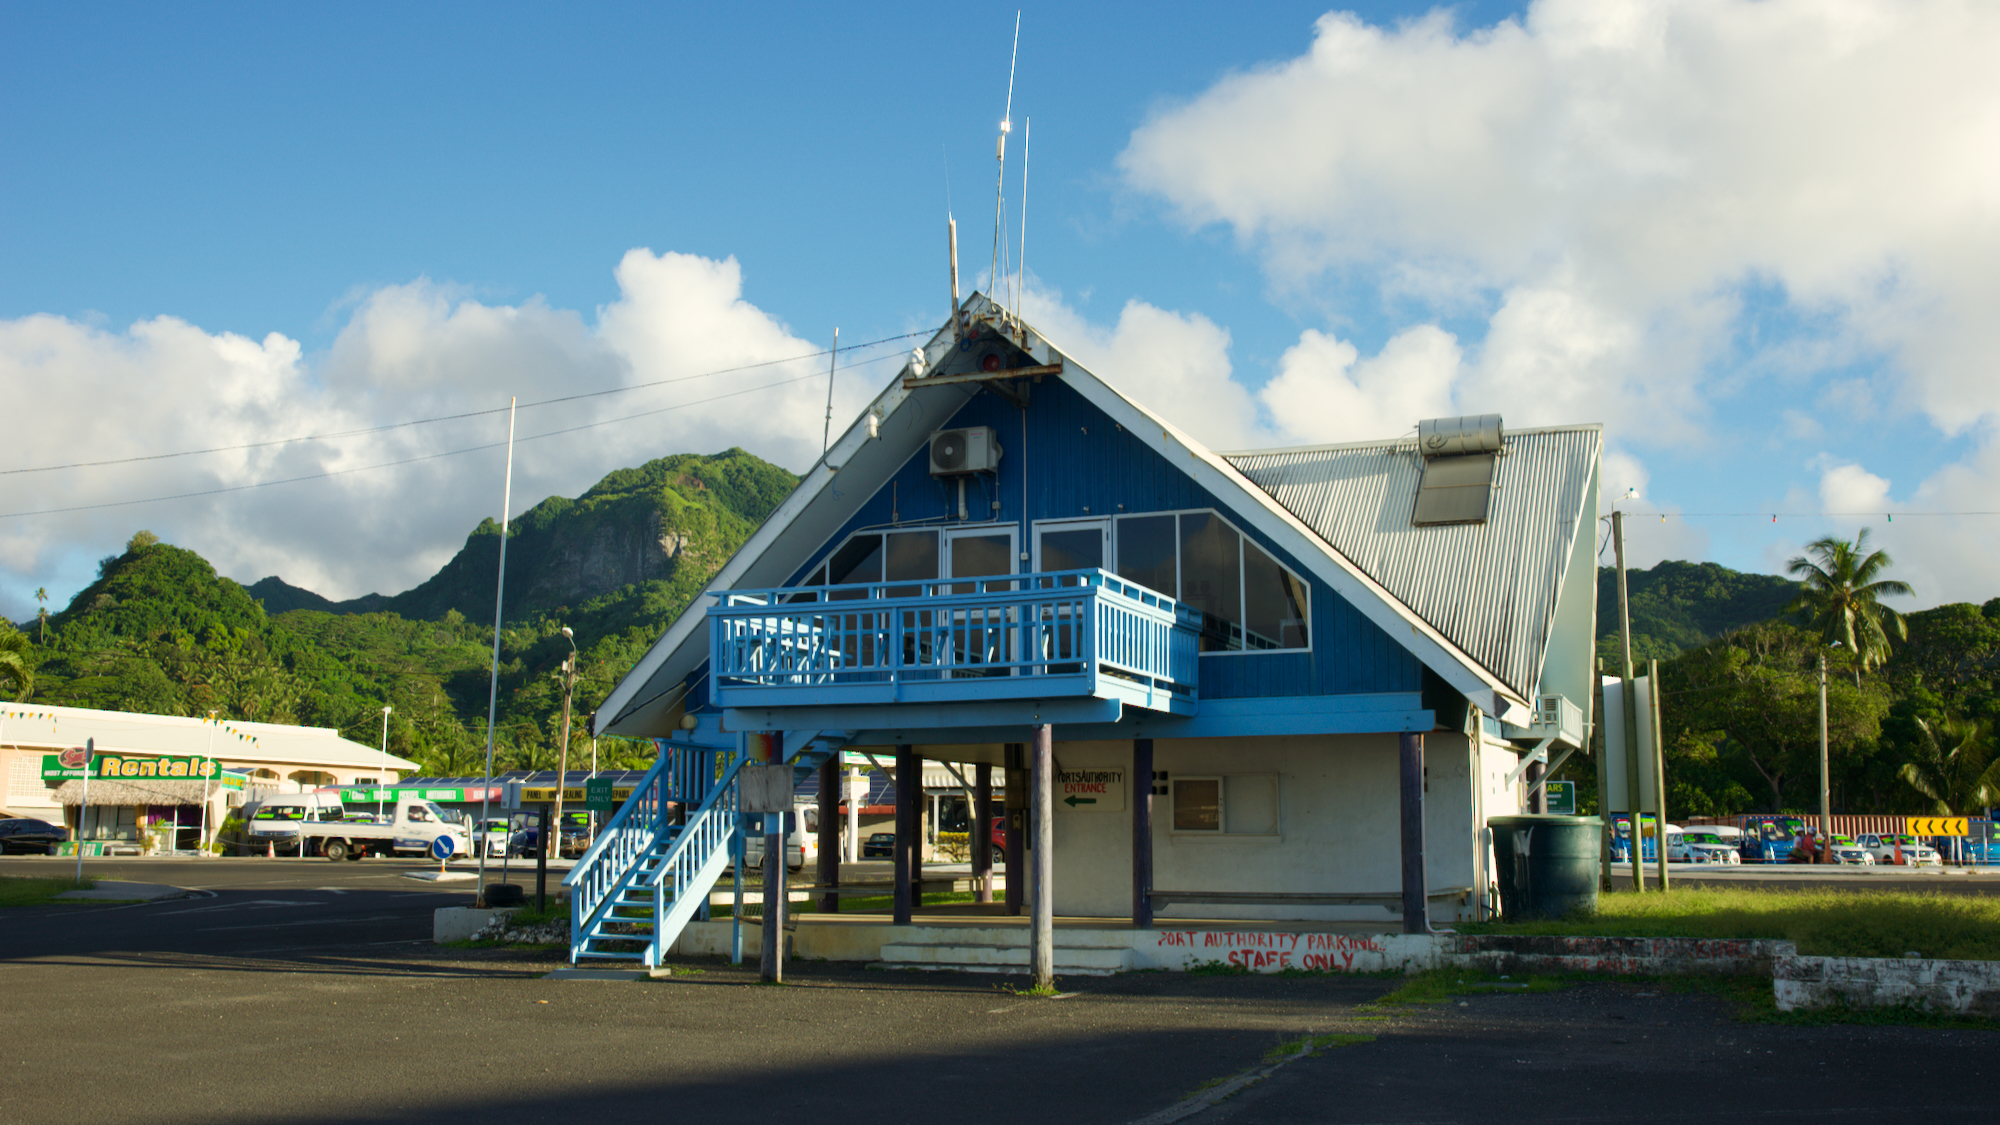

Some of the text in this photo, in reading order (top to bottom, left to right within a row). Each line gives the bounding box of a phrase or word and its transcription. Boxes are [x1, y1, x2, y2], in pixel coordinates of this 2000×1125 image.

[100, 757, 216, 777] Rentals
[1064, 783, 1107, 793] ENTRANCE
[1547, 784, 1563, 792] ARS
[373, 790, 392, 800] TRCKS
[527, 790, 542, 799] PANEL
[612, 789, 630, 799] EPAIRS
[1204, 932, 1299, 950] AUTHORITY
[1303, 951, 1355, 972] ONLY
